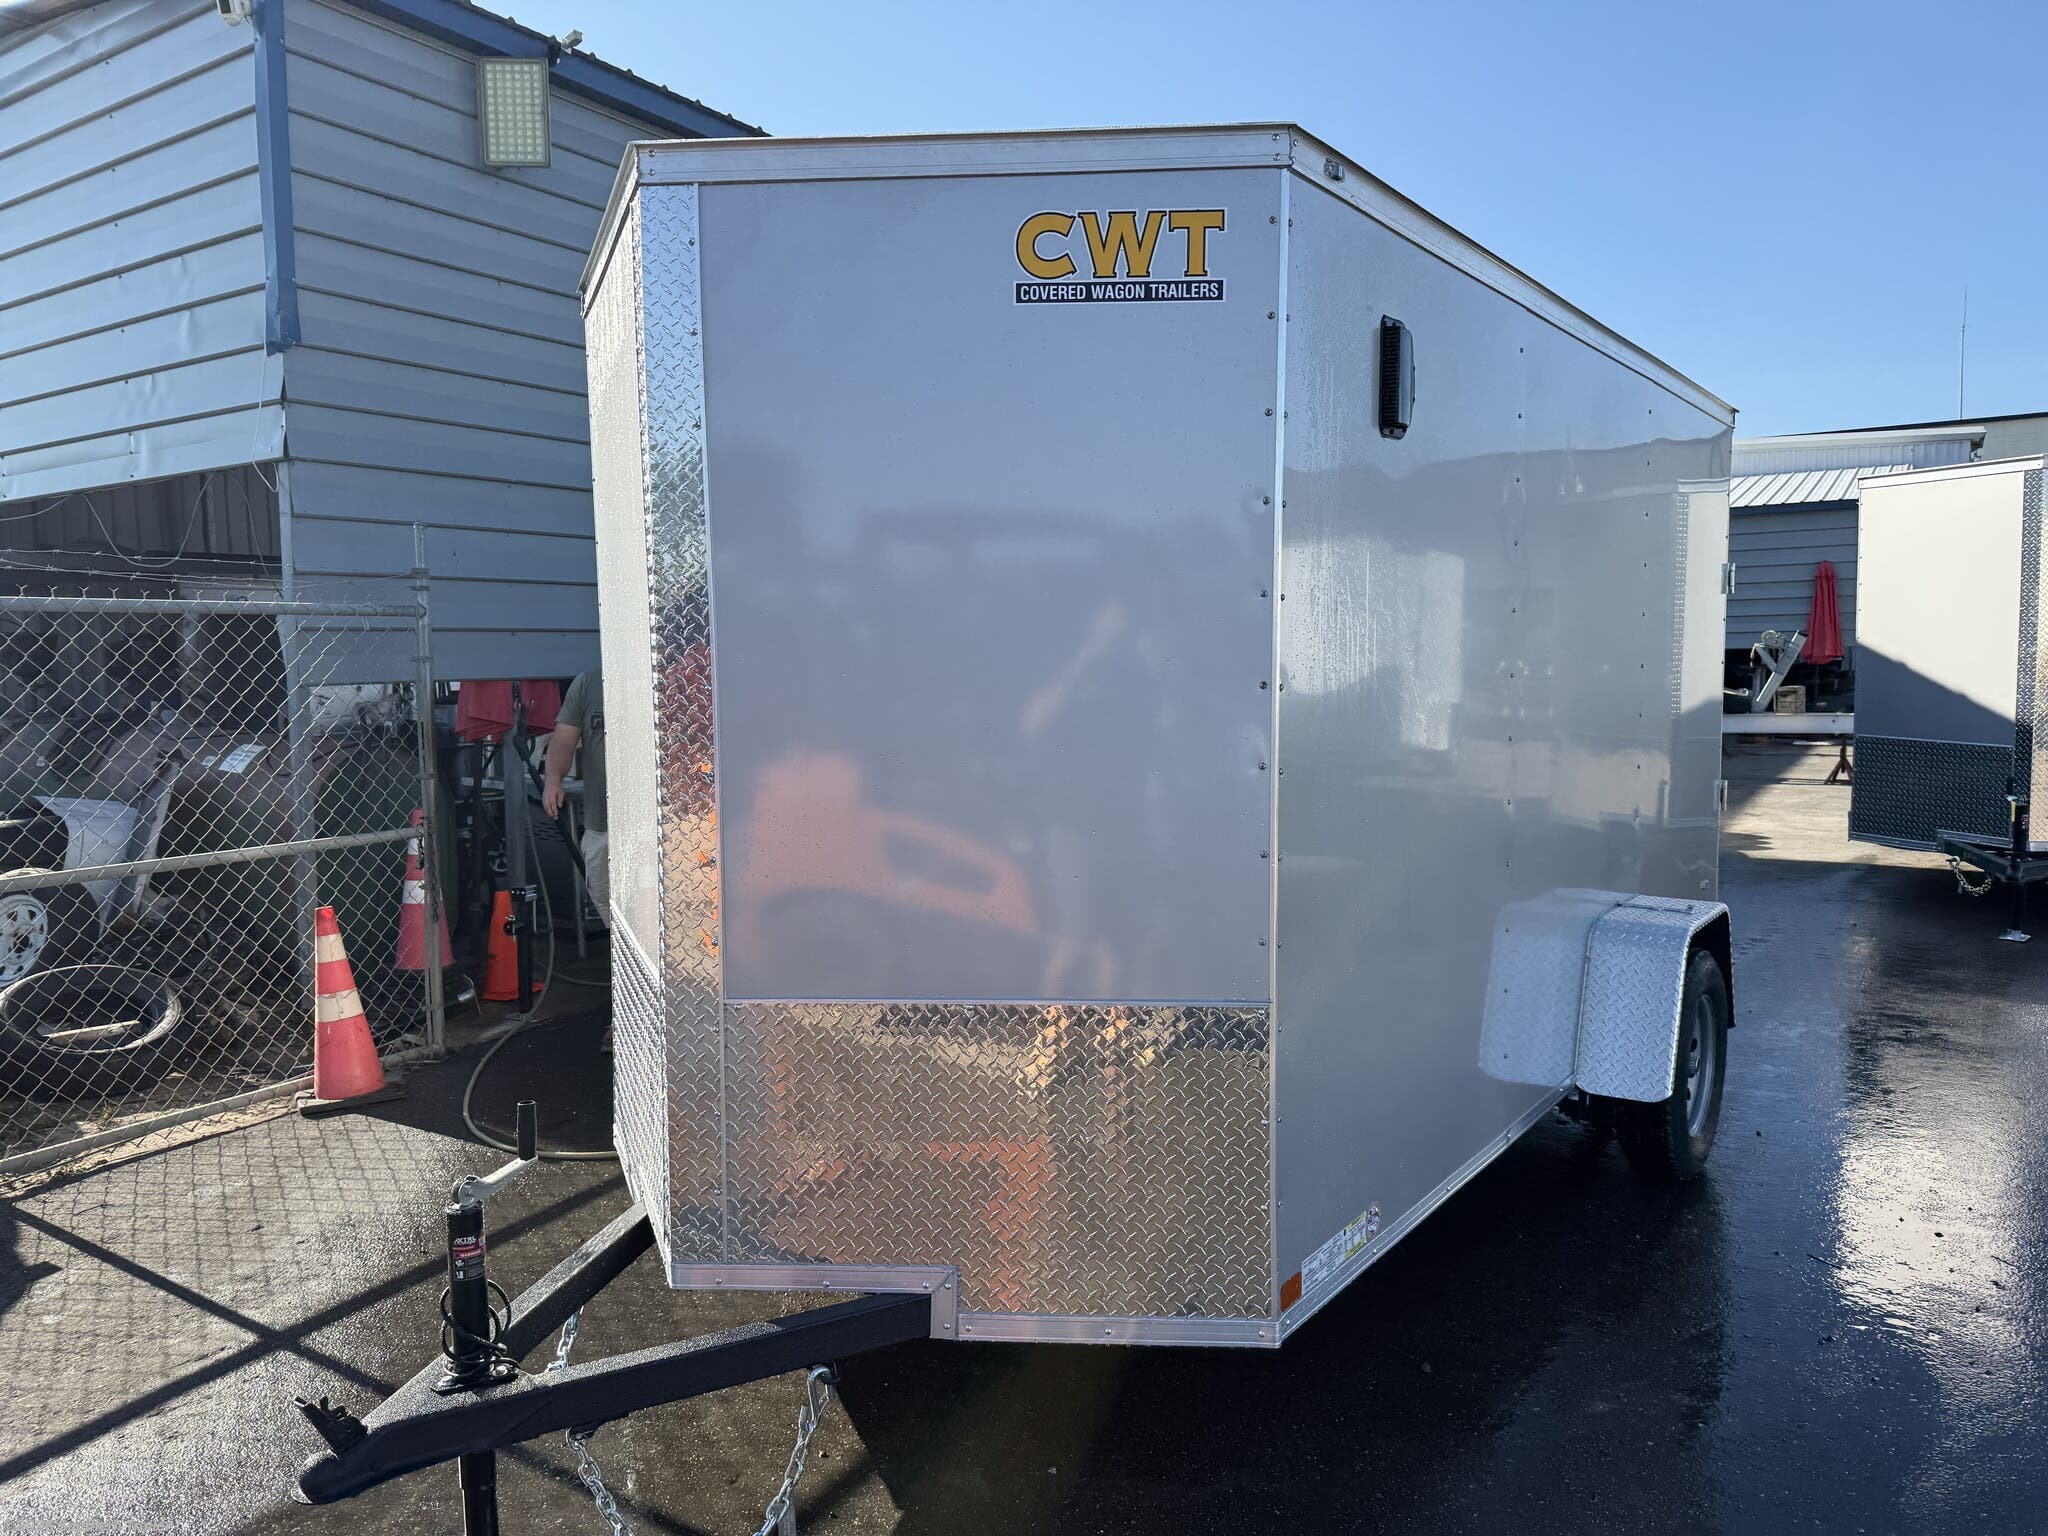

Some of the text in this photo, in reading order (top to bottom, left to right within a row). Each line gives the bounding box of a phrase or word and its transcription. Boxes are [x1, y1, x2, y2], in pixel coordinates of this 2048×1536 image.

[1016, 209, 1225, 280] CWT
[1020, 283, 1219, 300] COVERED WAGON TRAILERS
